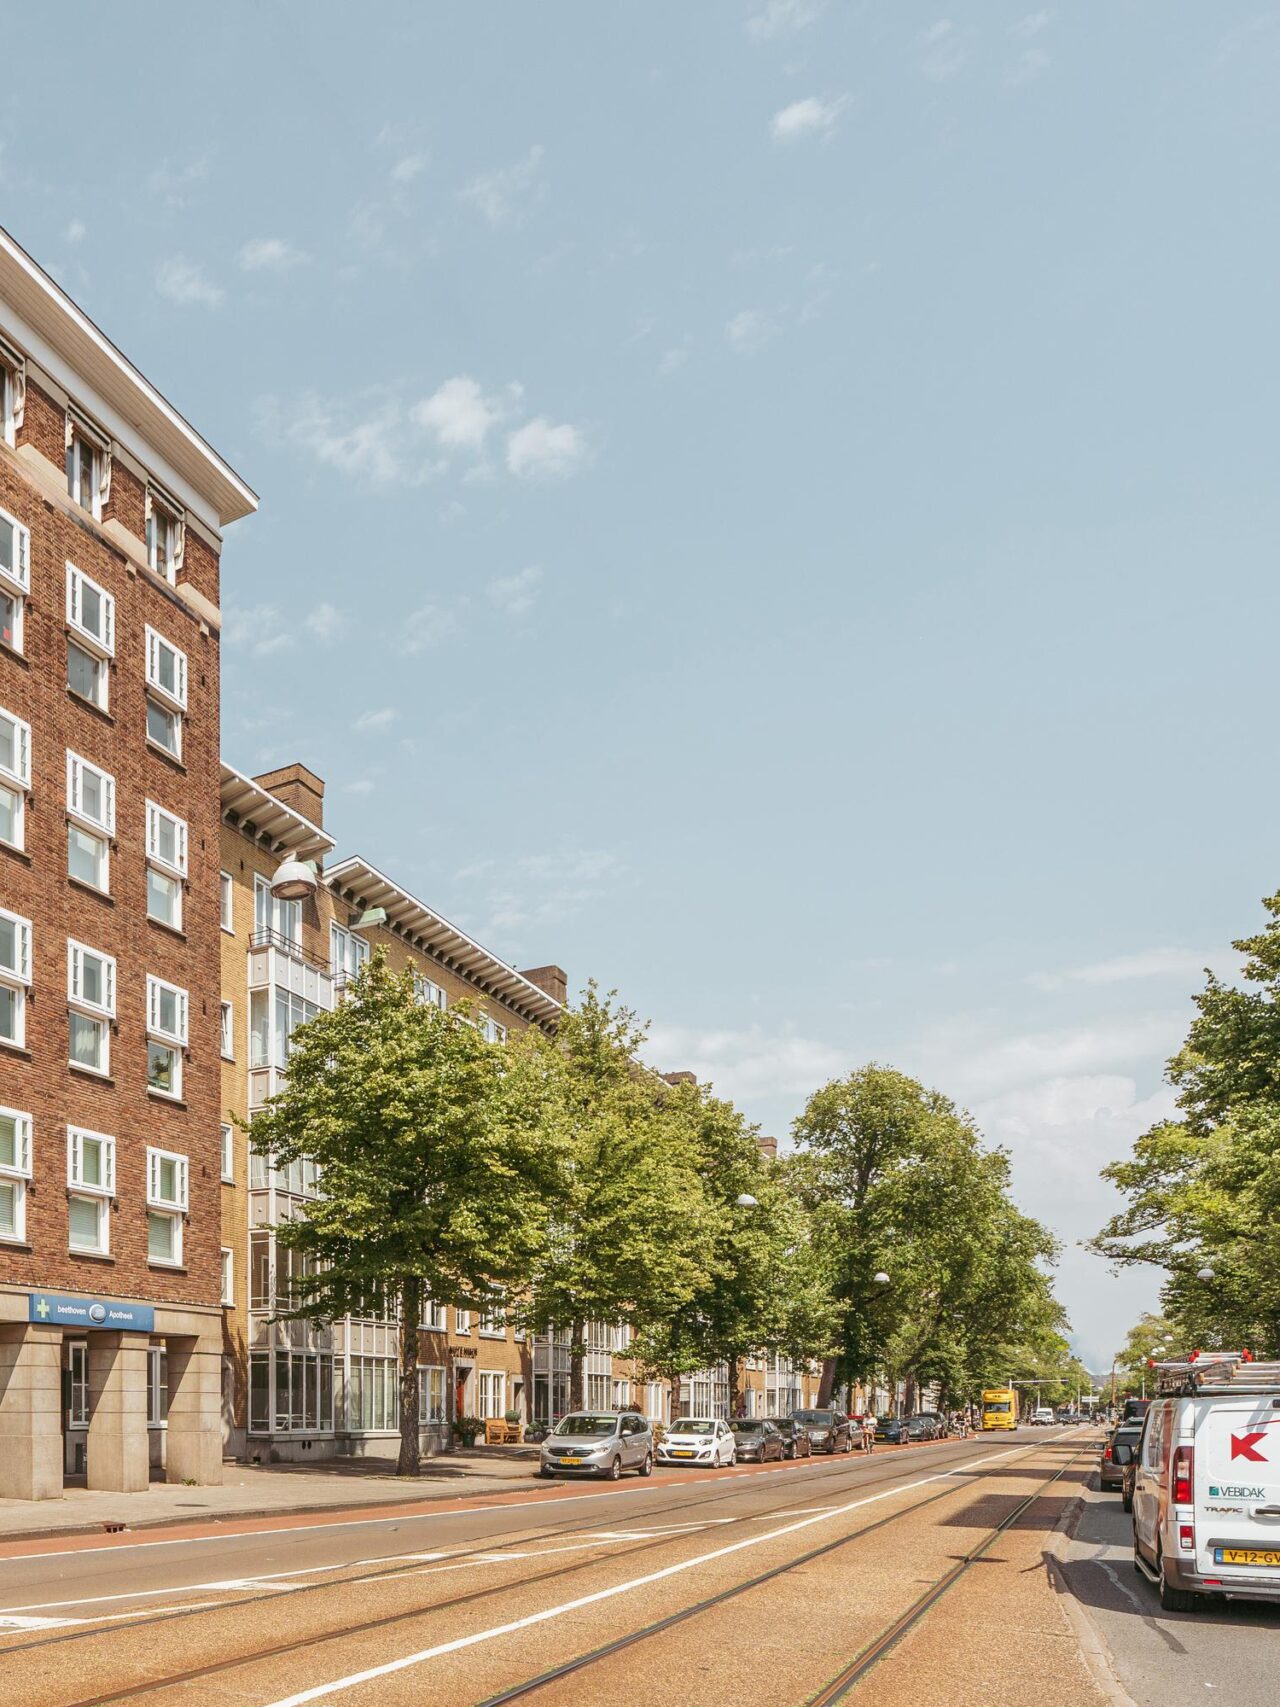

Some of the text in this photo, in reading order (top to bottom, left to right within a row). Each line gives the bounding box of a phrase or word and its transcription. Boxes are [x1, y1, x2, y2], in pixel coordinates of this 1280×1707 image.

[57, 1305, 86, 1315] beethoven
[109, 1311, 133, 1320] Apotheek
[1220, 1487, 1265, 1498] VEBIDAK
[1204, 1506, 1244, 1514] TRAFIC
